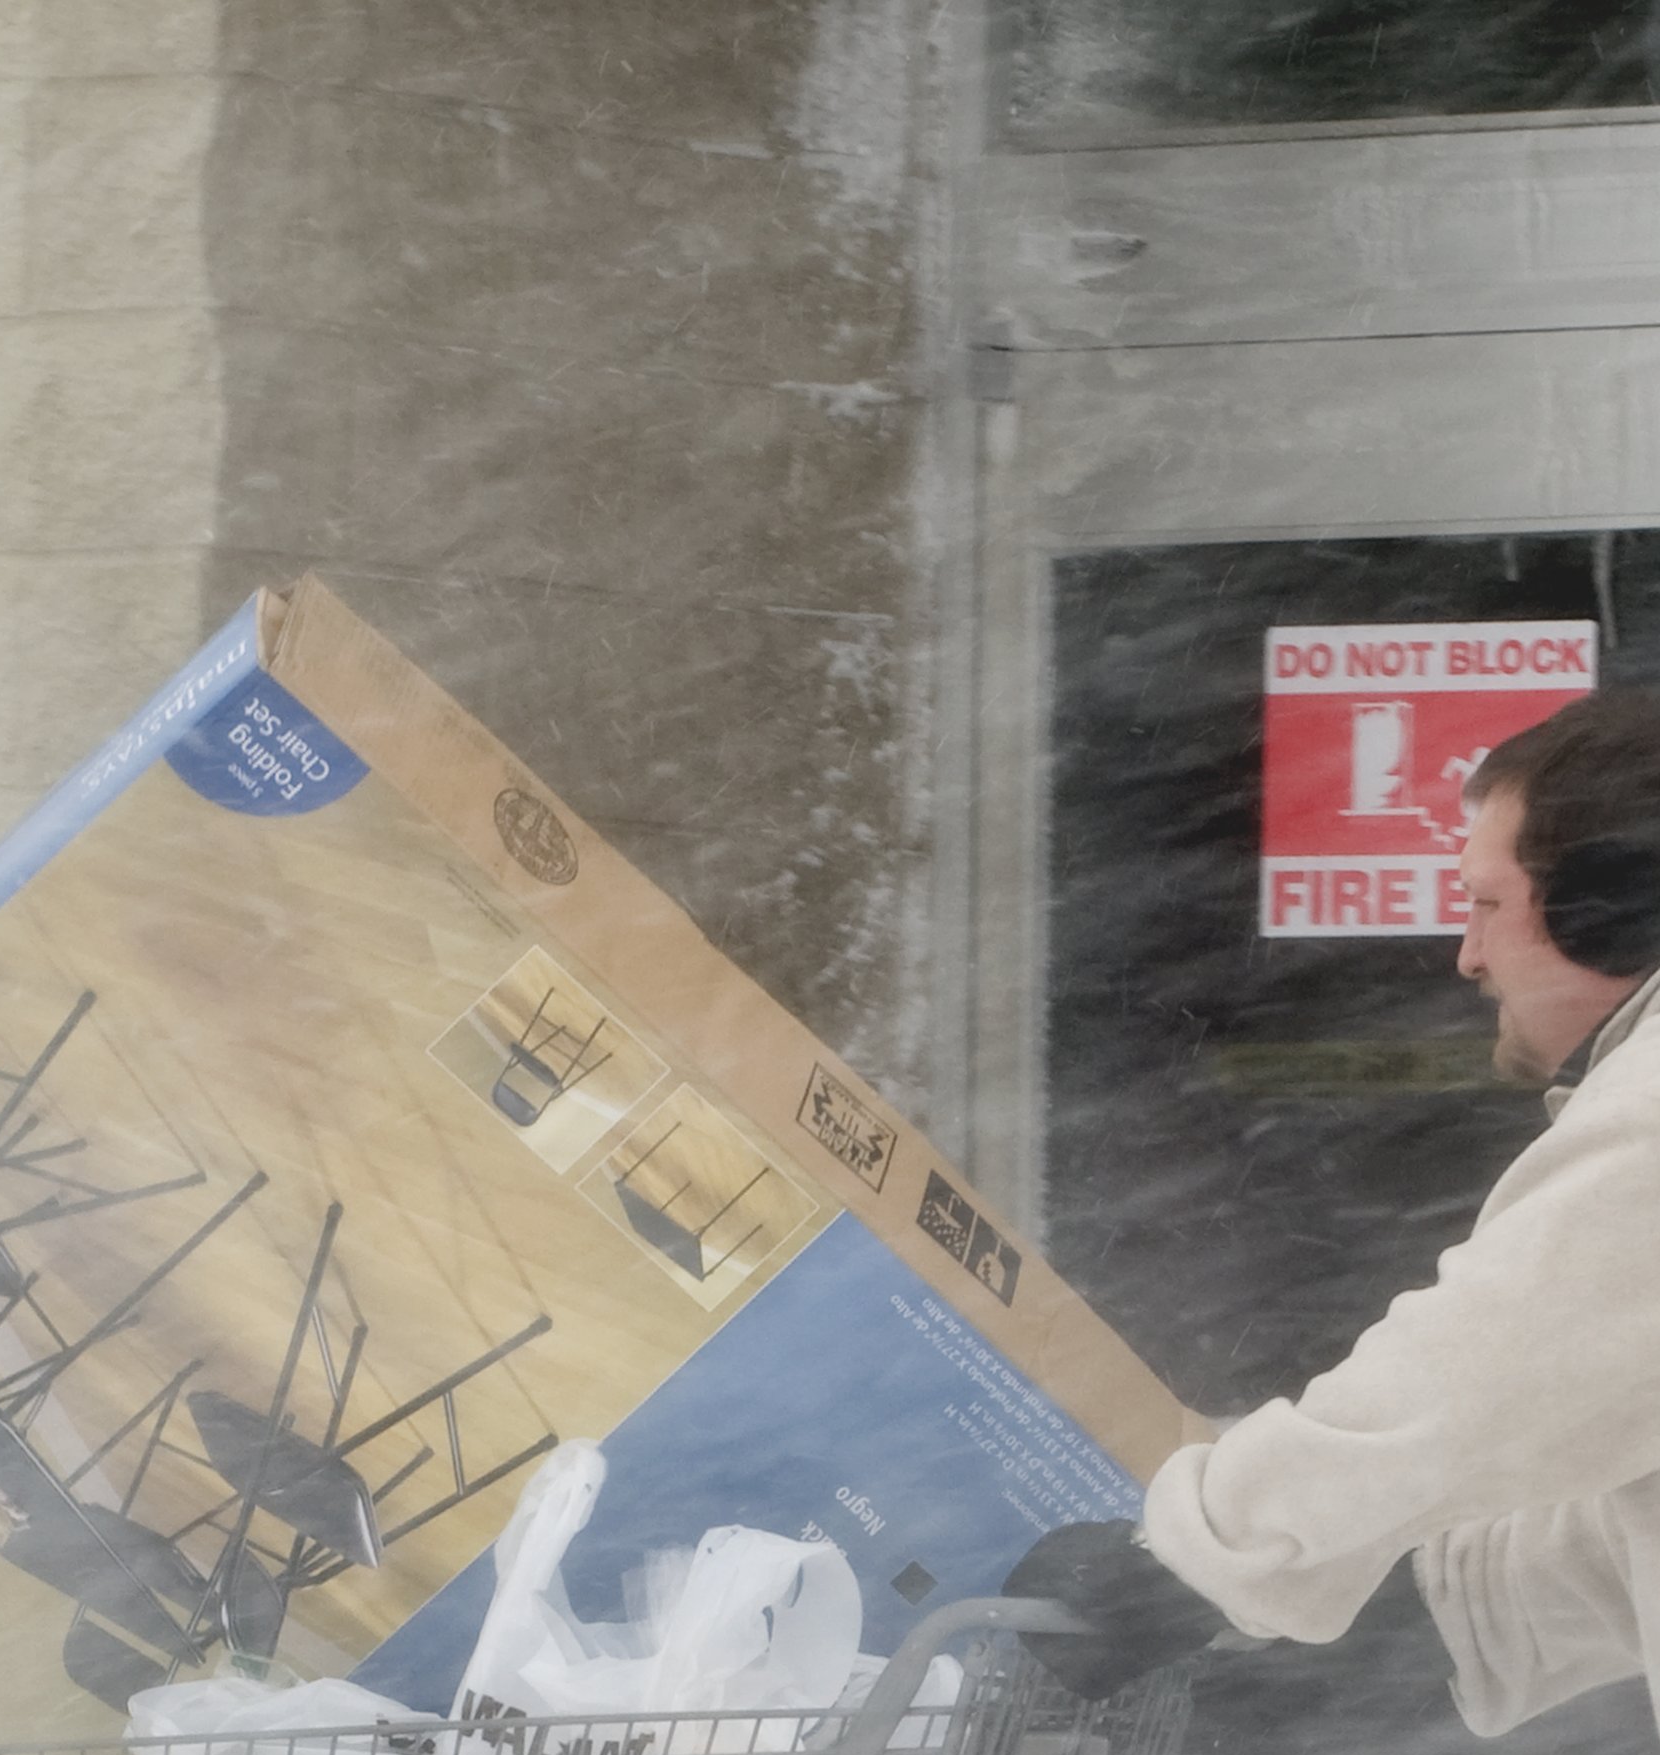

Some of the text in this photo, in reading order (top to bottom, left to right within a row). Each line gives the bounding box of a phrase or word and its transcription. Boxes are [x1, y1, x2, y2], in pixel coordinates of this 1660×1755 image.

[1274, 638, 1589, 679] DO NOT BLOCK
[245, 699, 329, 781] Chair Set
[230, 724, 301, 799] Folding
[1270, 869, 1417, 926] FIRE
[891, 1295, 914, 1318] Alto
[923, 1299, 946, 1321] Alto
[912, 1316, 929, 1331] de
[944, 1318, 961, 1334] de
[968, 1365, 1016, 1413] Profundo
[1000, 1370, 1048, 1418] Profundo
[944, 1404, 957, 1417] H
[968, 1401, 982, 1414] H
[1015, 1409, 1031, 1424] de
[1047, 1415, 1063, 1429] de
[1079, 1445, 1091, 1456] X
[1070, 1459, 1104, 1493] Ancho
[1090, 1453, 1124, 1487] Ancho
[836, 1487, 885, 1535] Negro
